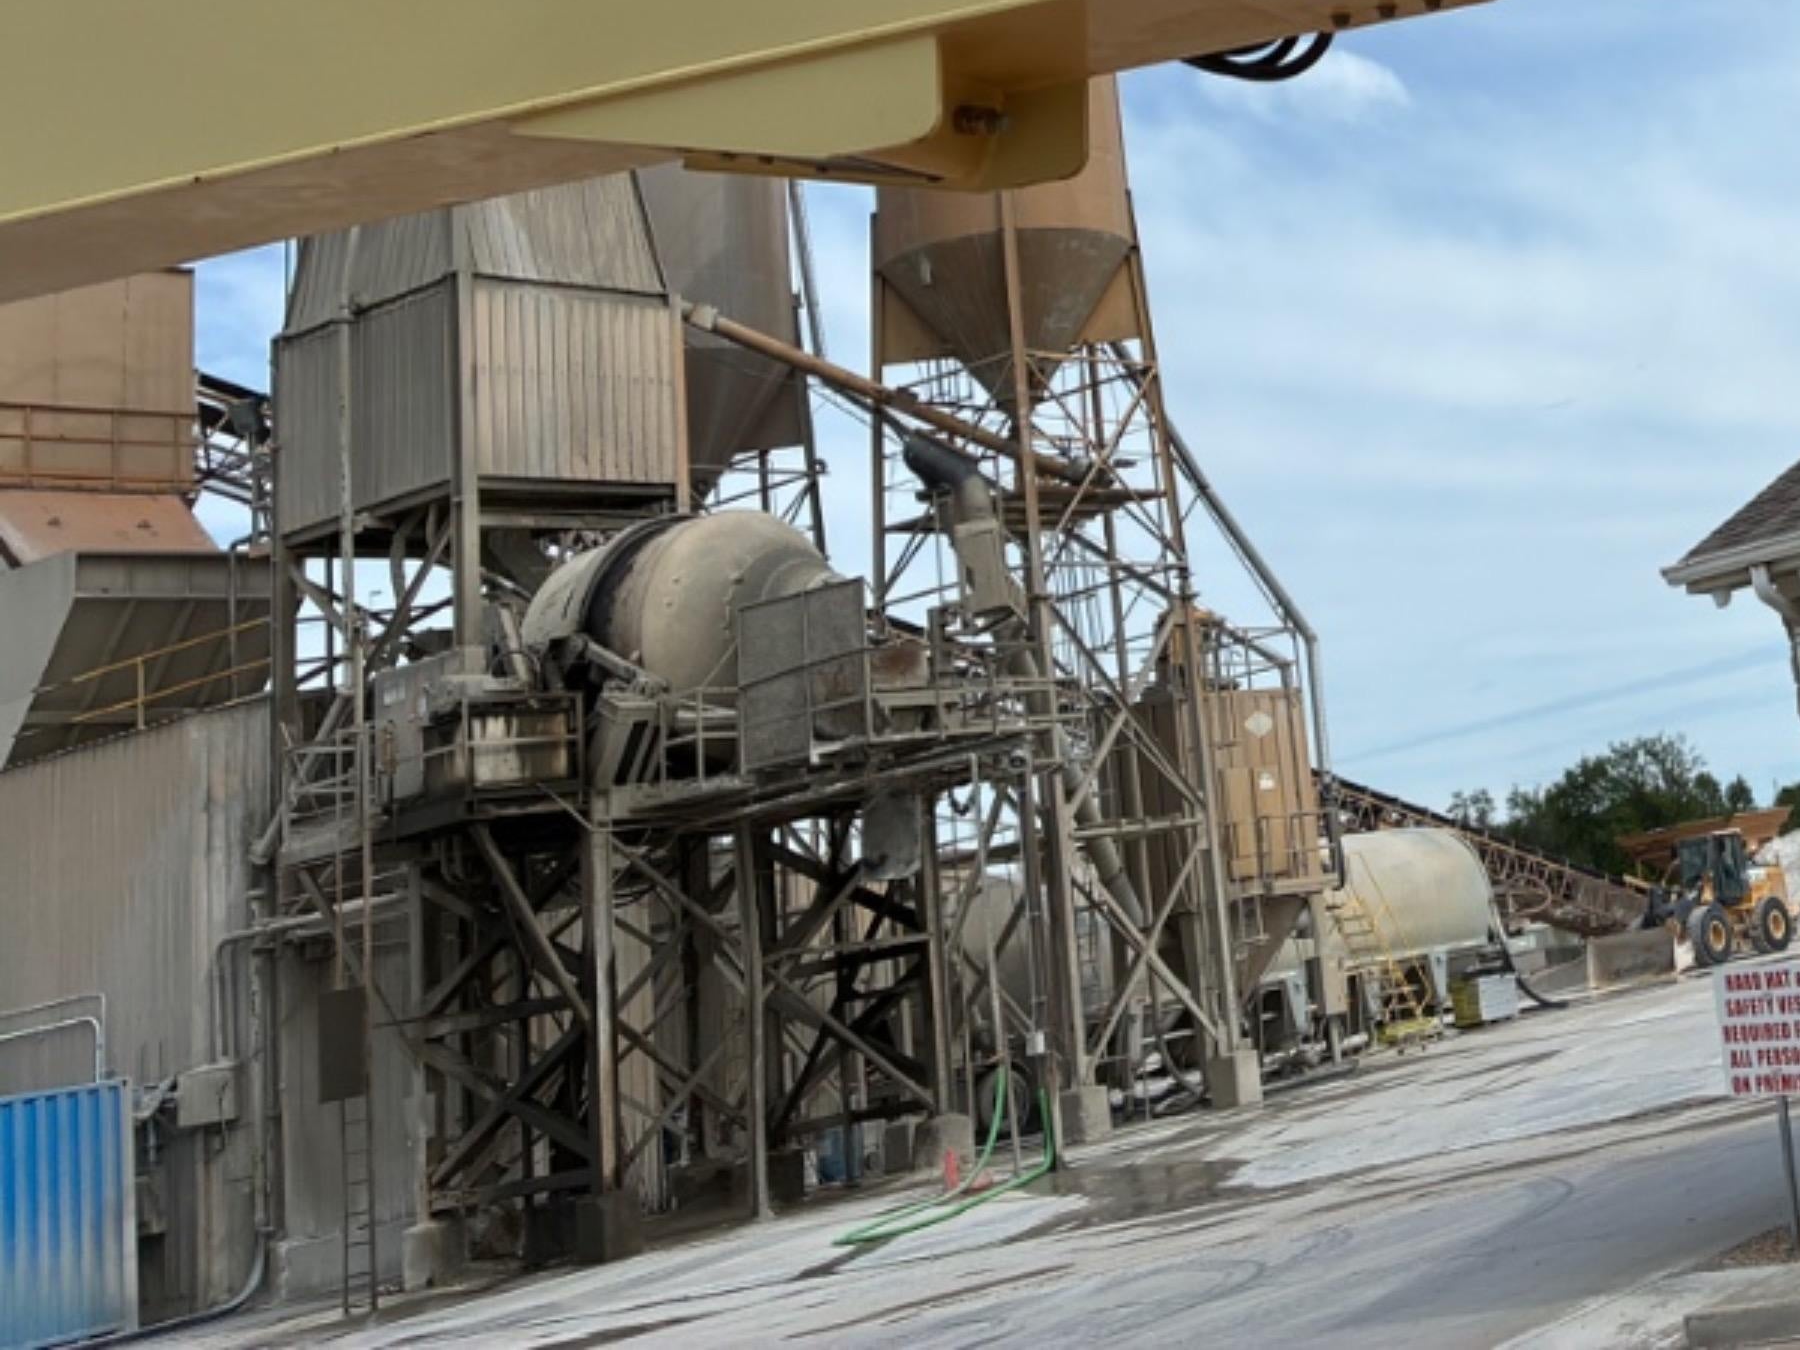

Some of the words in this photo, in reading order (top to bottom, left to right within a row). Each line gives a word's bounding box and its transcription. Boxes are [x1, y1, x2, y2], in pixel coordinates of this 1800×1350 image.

[1725, 972, 1761, 991] HARD
[1764, 970, 1791, 989] HAT
[1726, 995, 1773, 1017] SAFETY
[1723, 1023, 1791, 1043] REQUIRED
[1731, 1050, 1752, 1068] ALL
[1732, 1075, 1752, 1095] ON
